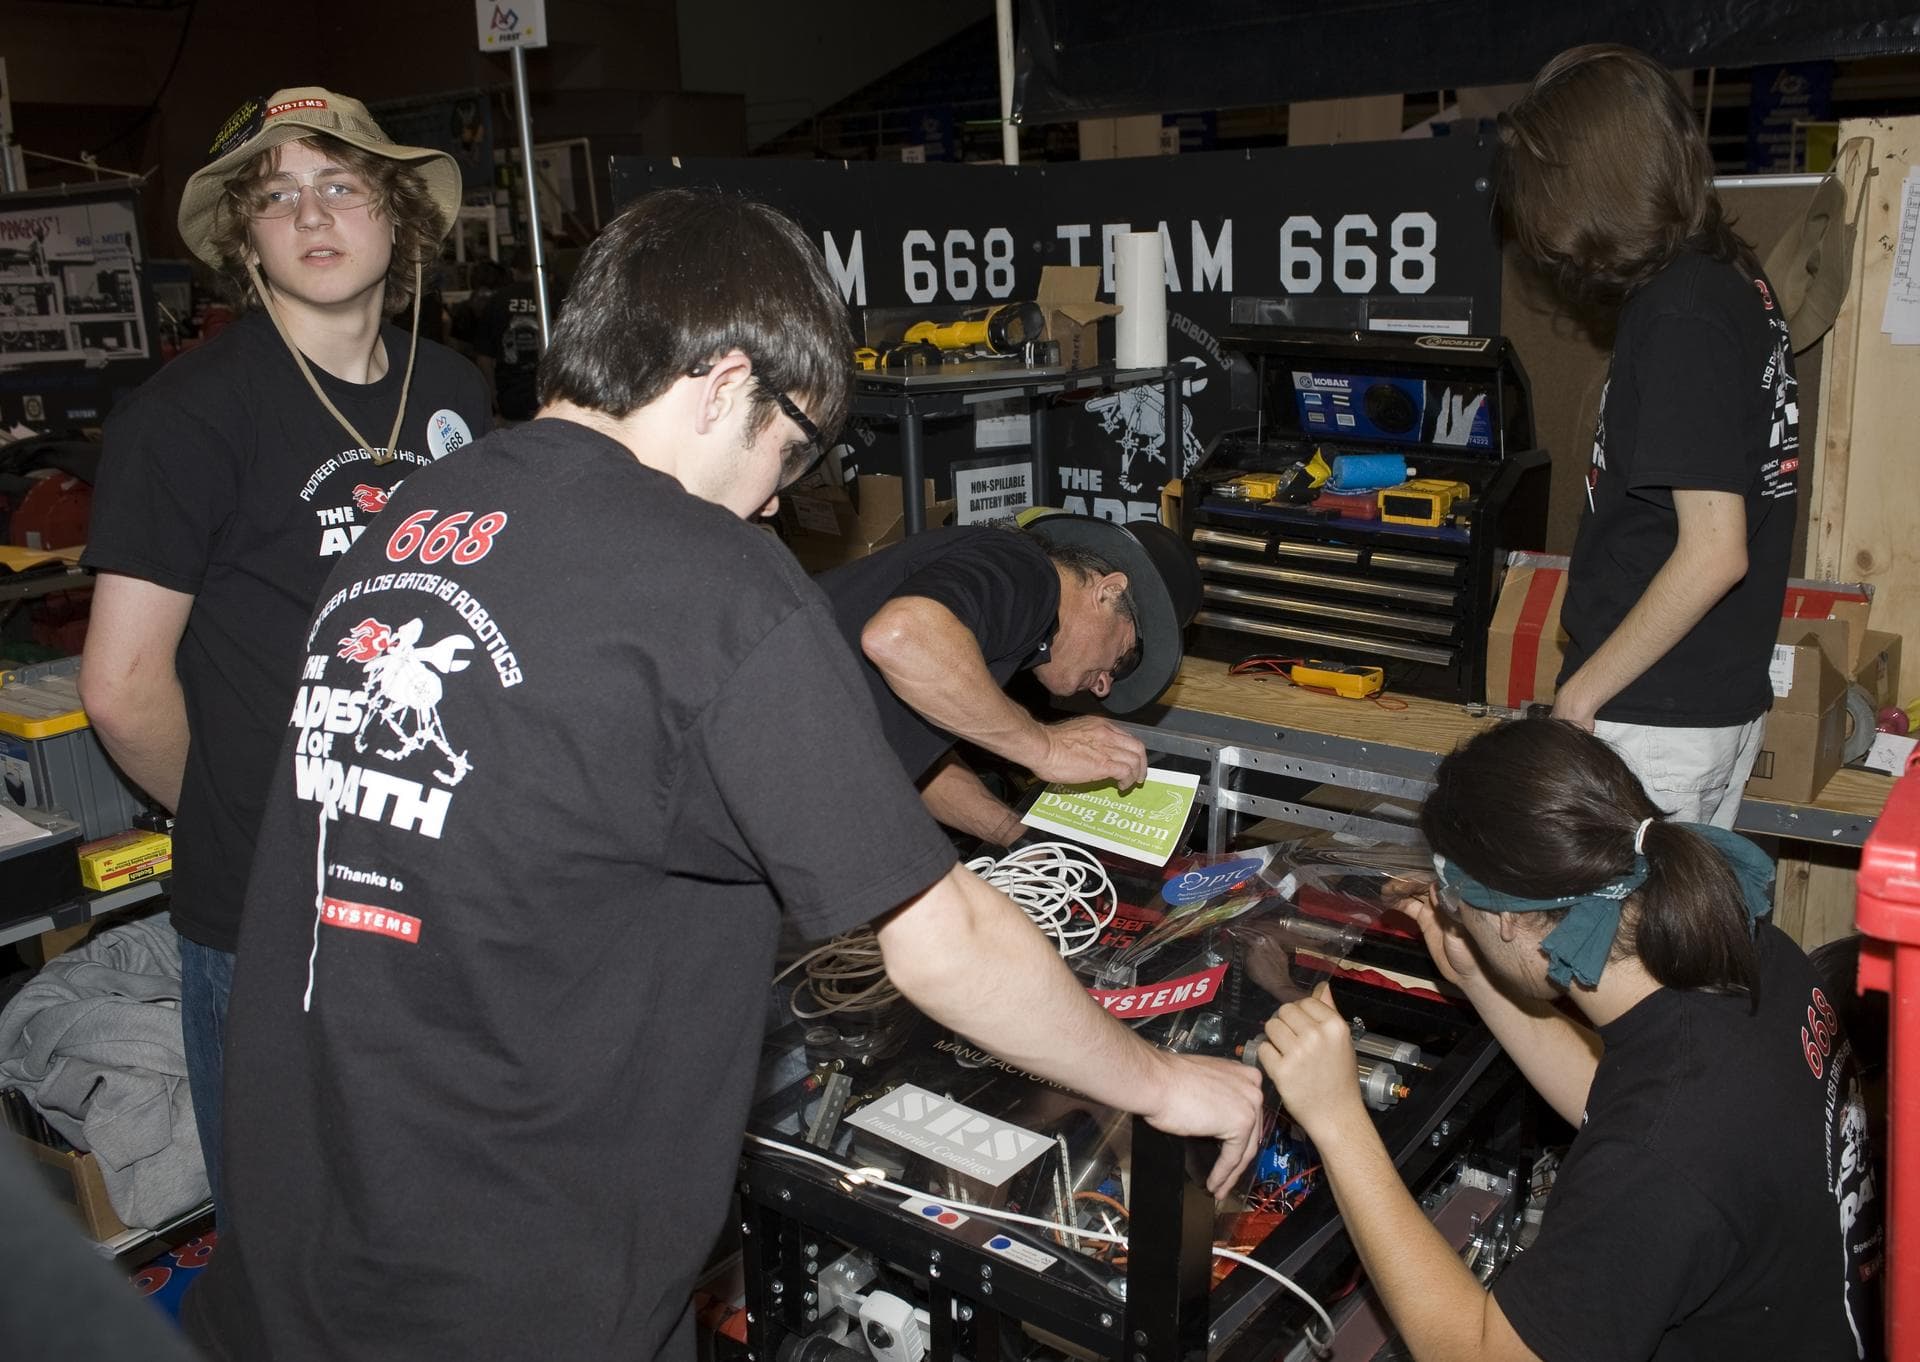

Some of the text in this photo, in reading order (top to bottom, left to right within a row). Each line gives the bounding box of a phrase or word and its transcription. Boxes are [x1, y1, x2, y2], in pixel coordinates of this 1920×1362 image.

[270, 99, 324, 115] SYSTEMS
[902, 228, 1017, 303] 668
[1280, 210, 1437, 294] 668
[1171, 312, 1234, 371] ROBOTICS
[1441, 337, 1482, 347] KOBALT
[1313, 377, 1350, 388] KOBALT
[299, 457, 341, 502] PIONEER
[337, 448, 360, 465] LOS
[400, 449, 416, 463] HS
[970, 474, 1026, 495] NON-SPILLABLE
[1058, 466, 1103, 492] THE
[316, 506, 356, 526] THE
[970, 491, 1027, 513] BATTERY INSIDE
[385, 509, 508, 566] 668
[363, 573, 397, 595] LOS
[393, 571, 442, 594] GATOS
[435, 578, 460, 602] HS
[449, 590, 524, 689] ROBOTICS
[288, 684, 370, 738] APES
[307, 730, 335, 759] OF
[295, 753, 454, 840] WRATH
[1053, 782, 1147, 818] Remembering
[1042, 793, 1170, 842] Doug Bourn
[130, 867, 154, 880] Scotch
[336, 864, 387, 888] Thanks
[390, 877, 404, 892] to
[326, 904, 413, 935] SYSTEMS
[1092, 976, 1212, 1012] YSTEMS
[1802, 987, 1838, 1081] 668
[864, 1115, 996, 1176] Industrial Coatings
